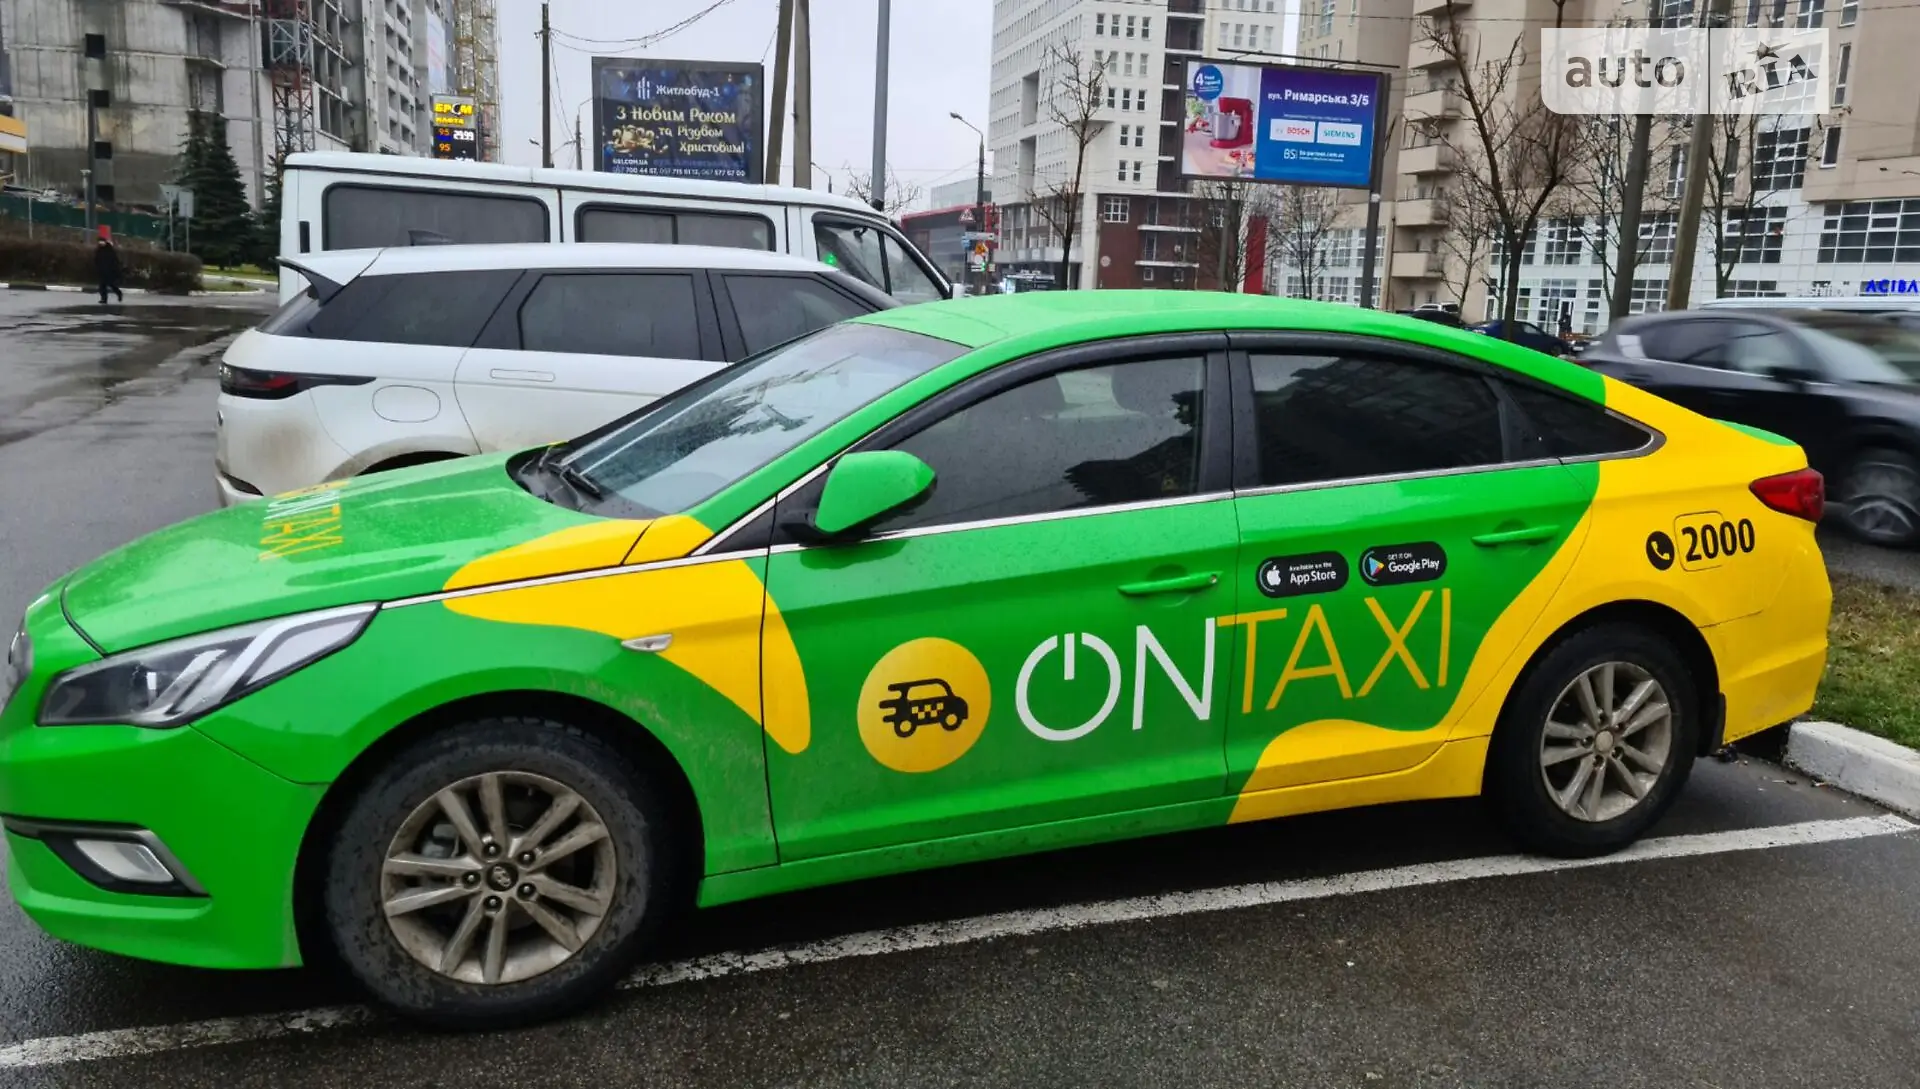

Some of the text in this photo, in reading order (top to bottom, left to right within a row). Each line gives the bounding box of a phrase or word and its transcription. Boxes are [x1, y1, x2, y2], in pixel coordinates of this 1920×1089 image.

[1195, 73, 1204, 85] 4
[656, 84, 720, 98] Житлобуд-1
[1350, 94, 1369, 107] 3/5
[631, 105, 684, 122] Новим
[690, 107, 736, 124] Роком
[658, 126, 723, 140] та Різдвом
[1287, 126, 1310, 136] BOSCH
[1323, 130, 1356, 139] SIEMENS
[439, 143, 451, 152] 95
[680, 141, 744, 155] Христовим!
[1681, 518, 1755, 562] 2000
[1388, 557, 1440, 574] Google Play
[1290, 570, 1337, 586] App Store
